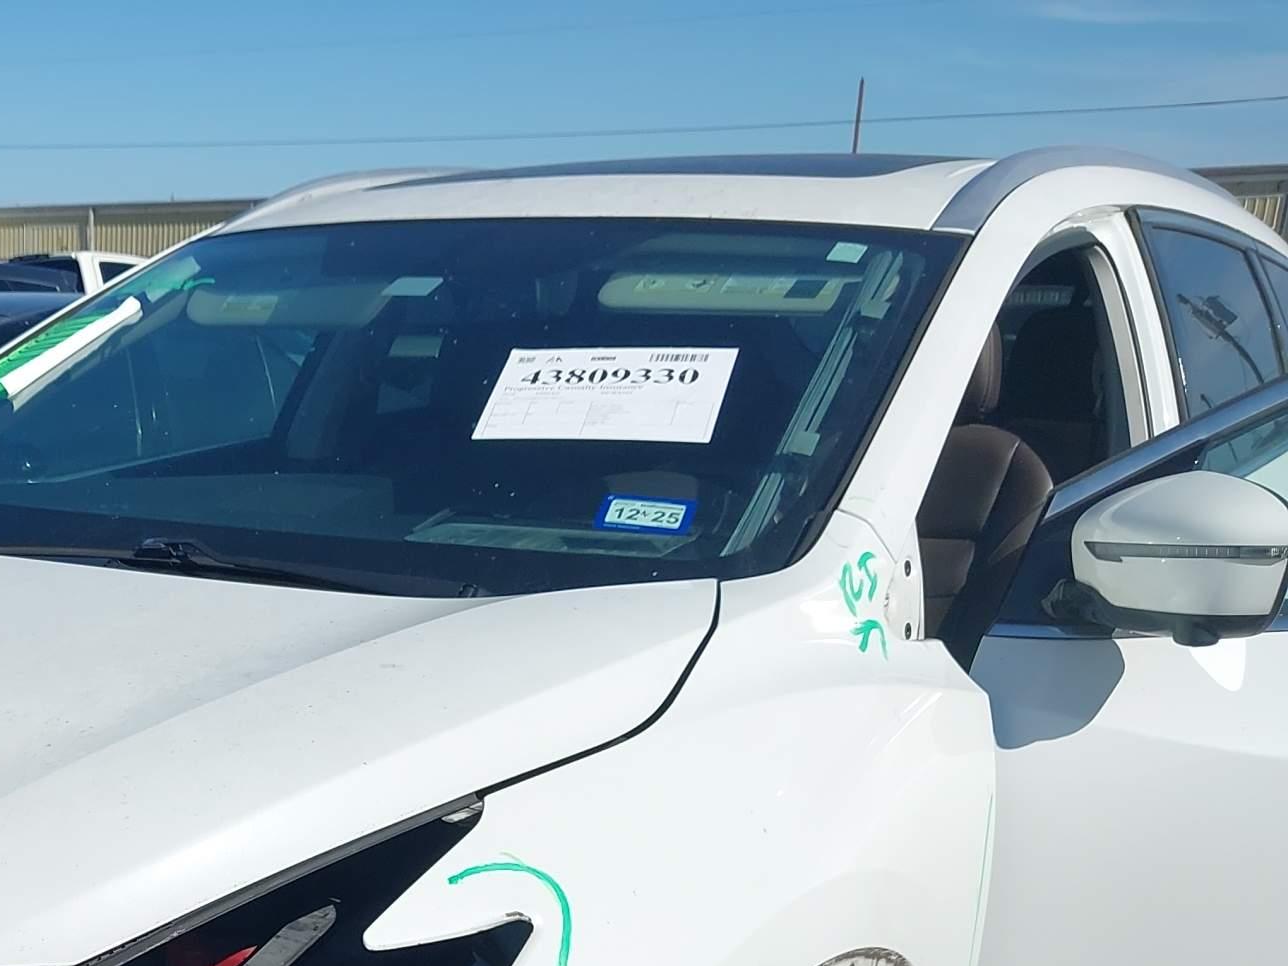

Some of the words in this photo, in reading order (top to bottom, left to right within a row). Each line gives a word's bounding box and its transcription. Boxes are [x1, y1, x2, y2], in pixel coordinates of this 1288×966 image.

[520, 367, 700, 385] 43809330
[503, 385, 555, 393] Progressive
[652, 510, 680, 524] 25
